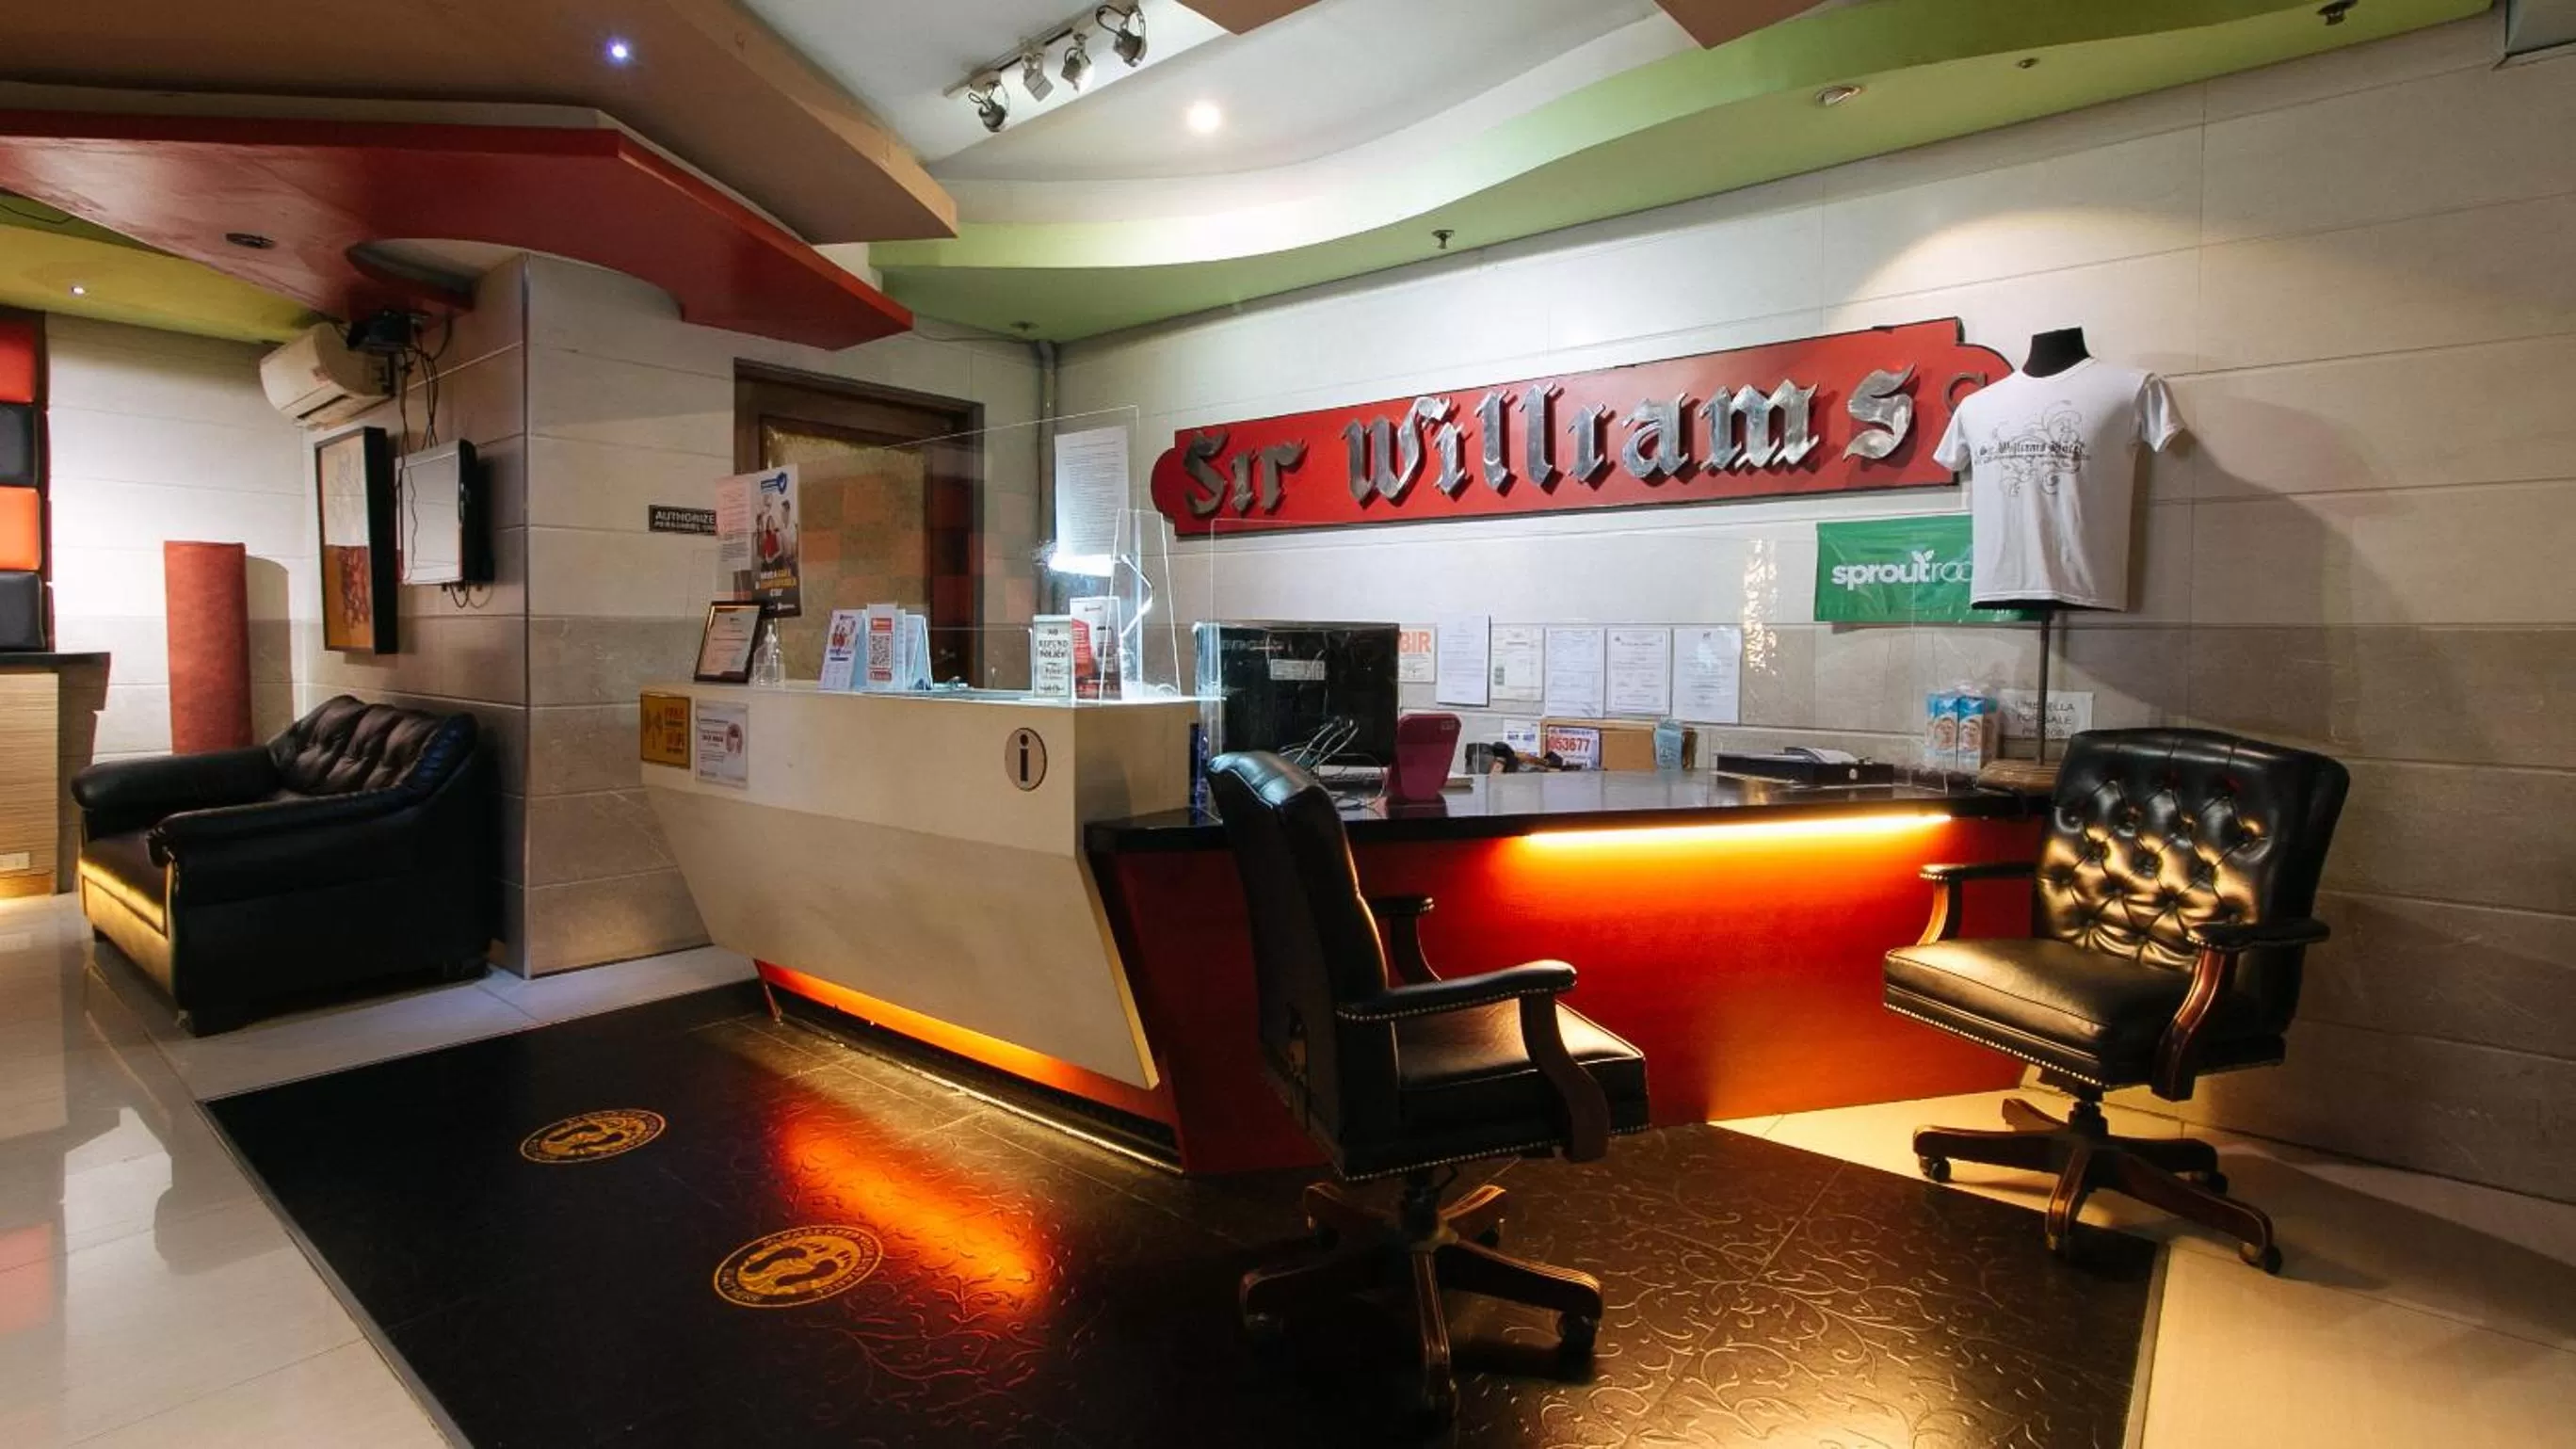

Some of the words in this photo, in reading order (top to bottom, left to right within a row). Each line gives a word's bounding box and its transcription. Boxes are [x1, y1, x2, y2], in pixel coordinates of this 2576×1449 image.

[1183, 429, 1307, 514] Sir
[655, 511, 716, 523] AUTHORIZE
[1831, 551, 1973, 590] sproutroo
[1400, 632, 1431, 652] BIR
